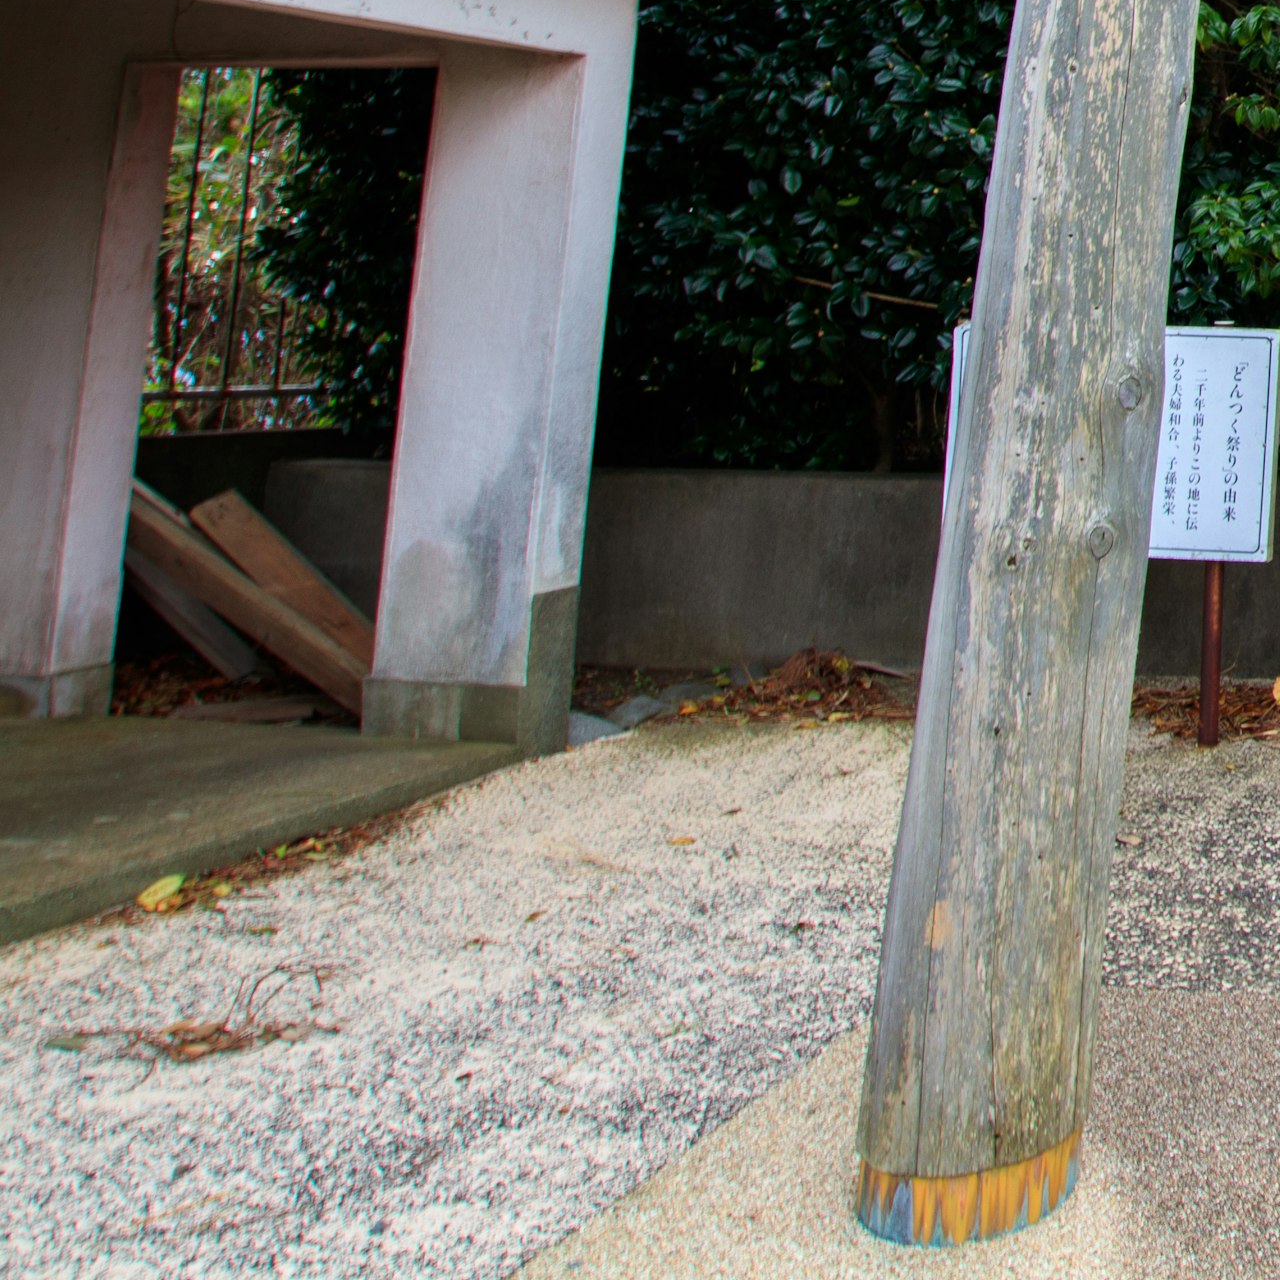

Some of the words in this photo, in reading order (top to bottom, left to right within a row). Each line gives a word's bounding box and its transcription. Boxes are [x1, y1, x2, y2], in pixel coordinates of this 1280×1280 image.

[1186, 369, 1208, 530] 二千年前よりこの地に伝
